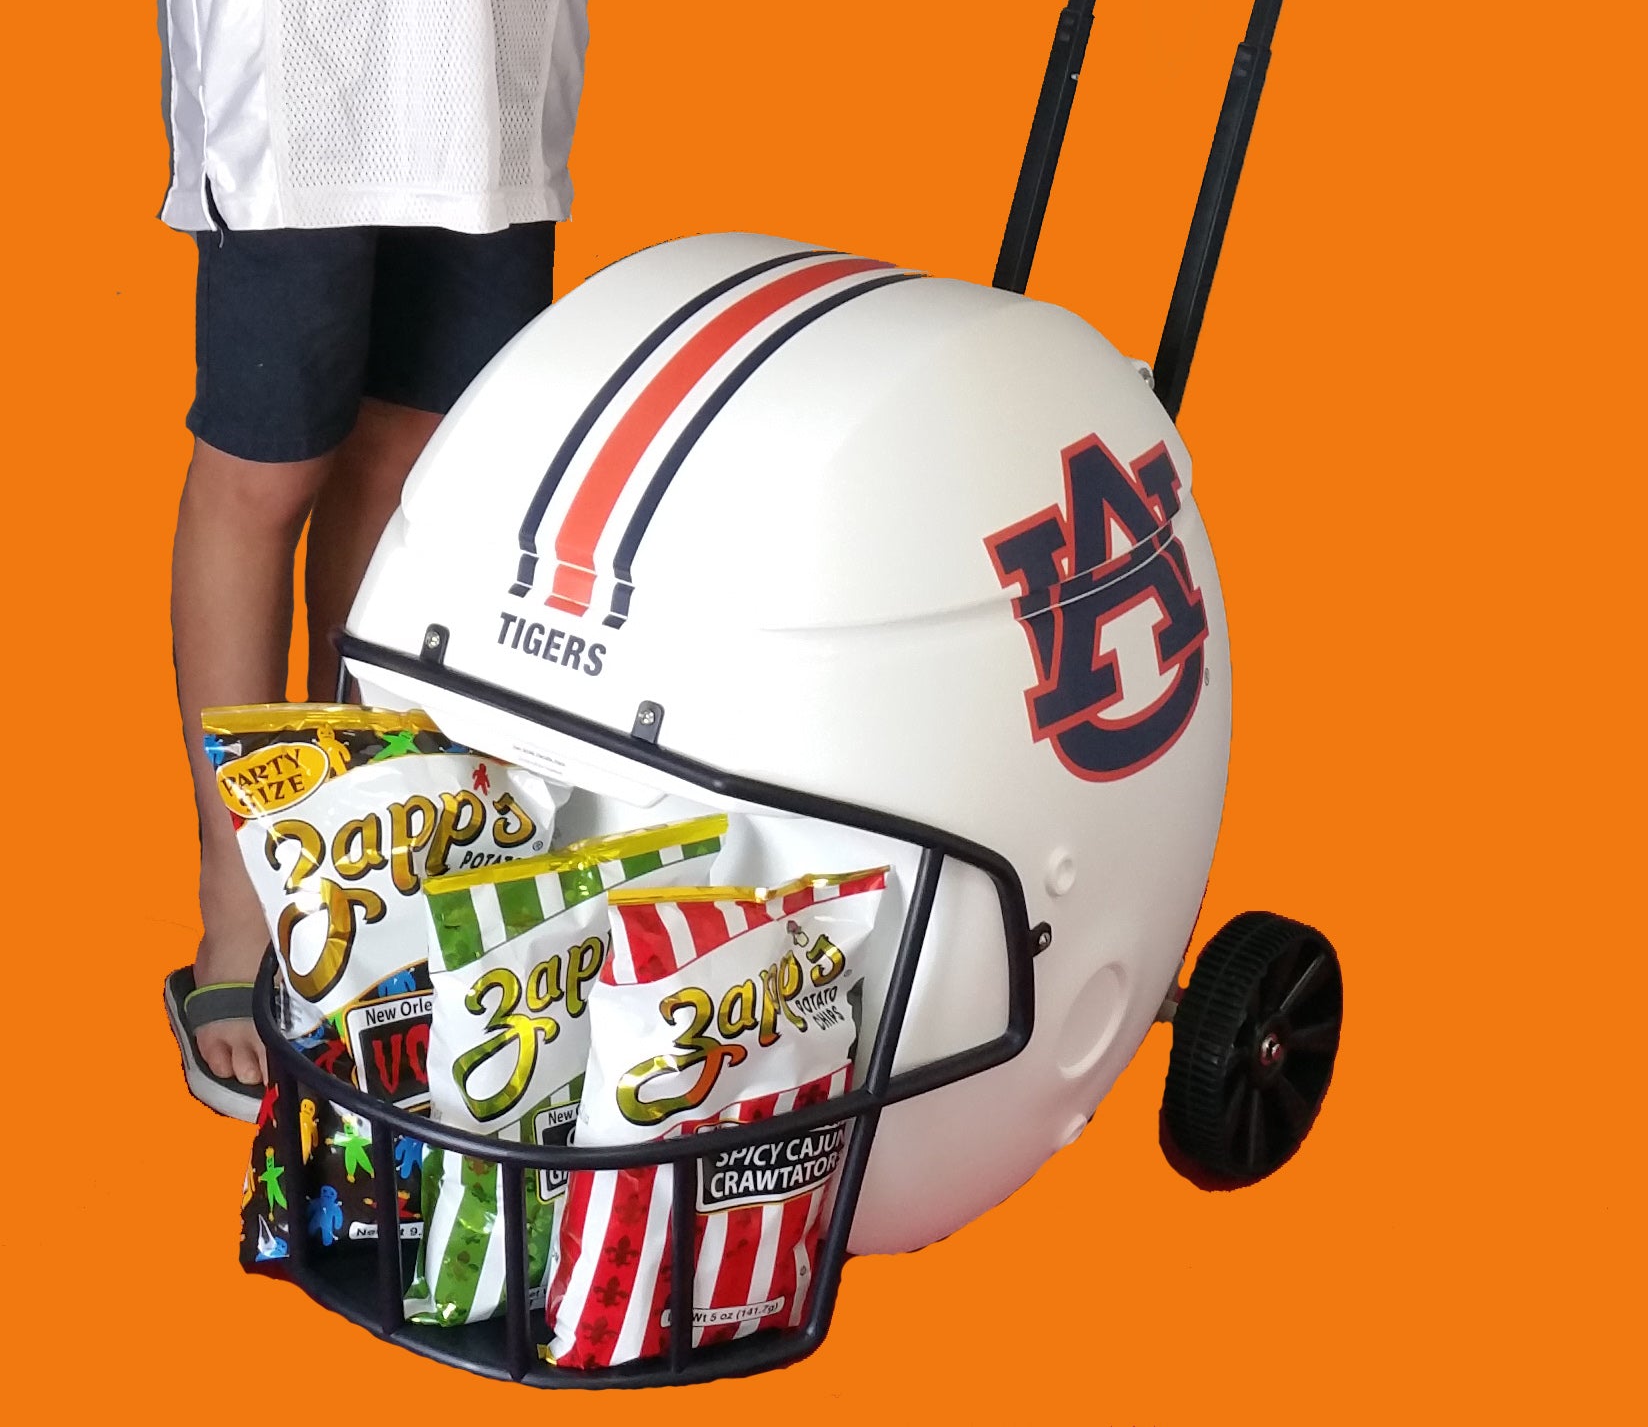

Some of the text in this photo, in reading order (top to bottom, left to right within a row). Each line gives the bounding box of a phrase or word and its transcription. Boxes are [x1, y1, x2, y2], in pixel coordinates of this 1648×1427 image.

[497, 611, 607, 677] TIGERS
[220, 748, 301, 797] PARTY
[459, 850, 521, 869] POTA
[794, 985, 838, 1015] POTATO
[365, 1007, 396, 1026] New
[812, 1006, 845, 1031] CHIPS
[547, 1109, 573, 1126] New
[715, 1128, 845, 1168] SPICY CAJUN
[692, 1312, 707, 1323] Wt
[710, 1312, 717, 1322] 5
[720, 1312, 733, 1321] oz
